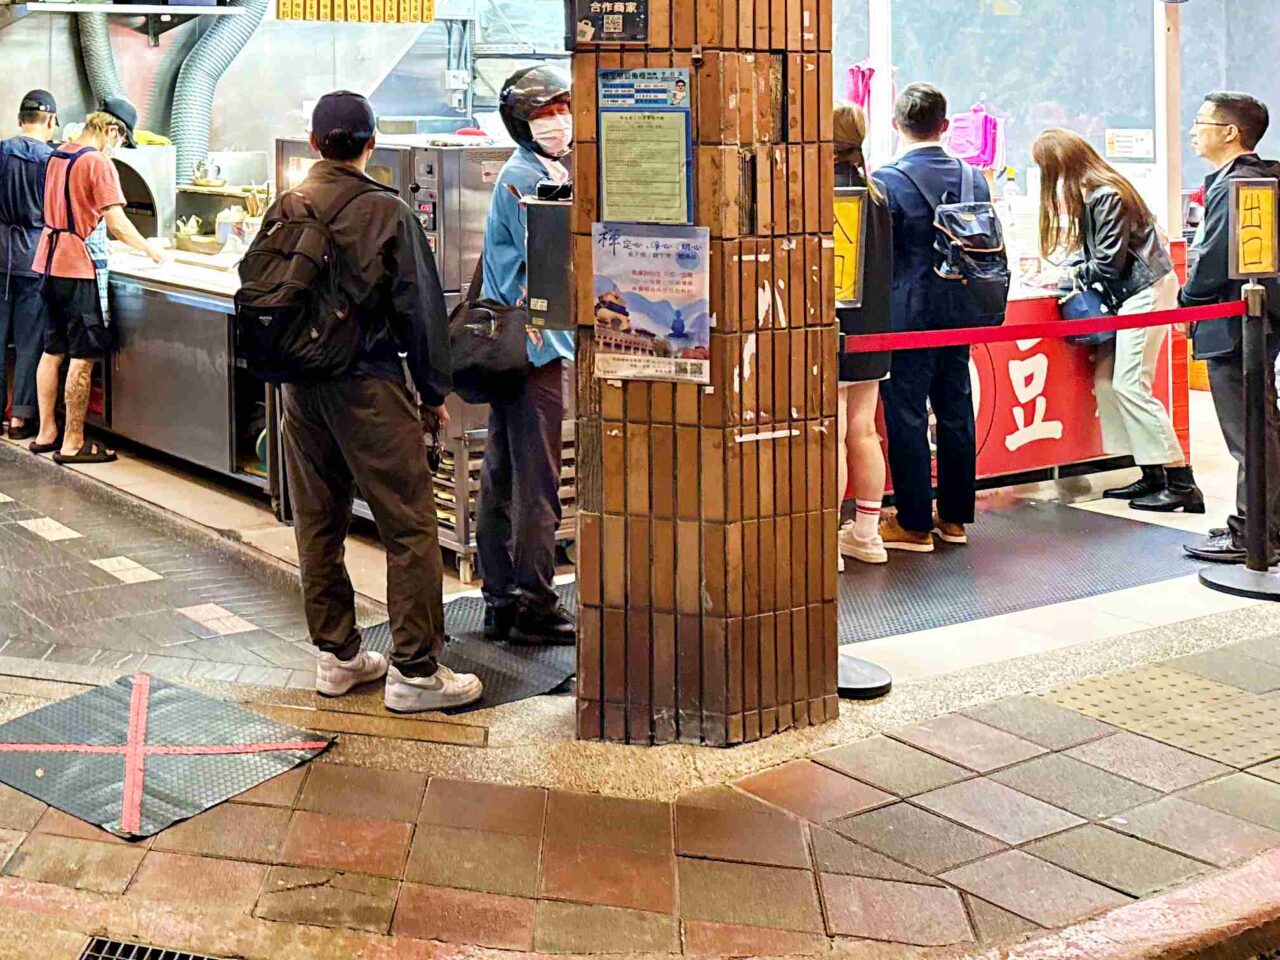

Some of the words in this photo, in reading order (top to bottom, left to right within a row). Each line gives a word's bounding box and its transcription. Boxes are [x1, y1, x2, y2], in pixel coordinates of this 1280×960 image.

[590, 1, 637, 13] 合作商家
[1241, 192, 1263, 267] 出口
[1005, 337, 1064, 452] 豆
